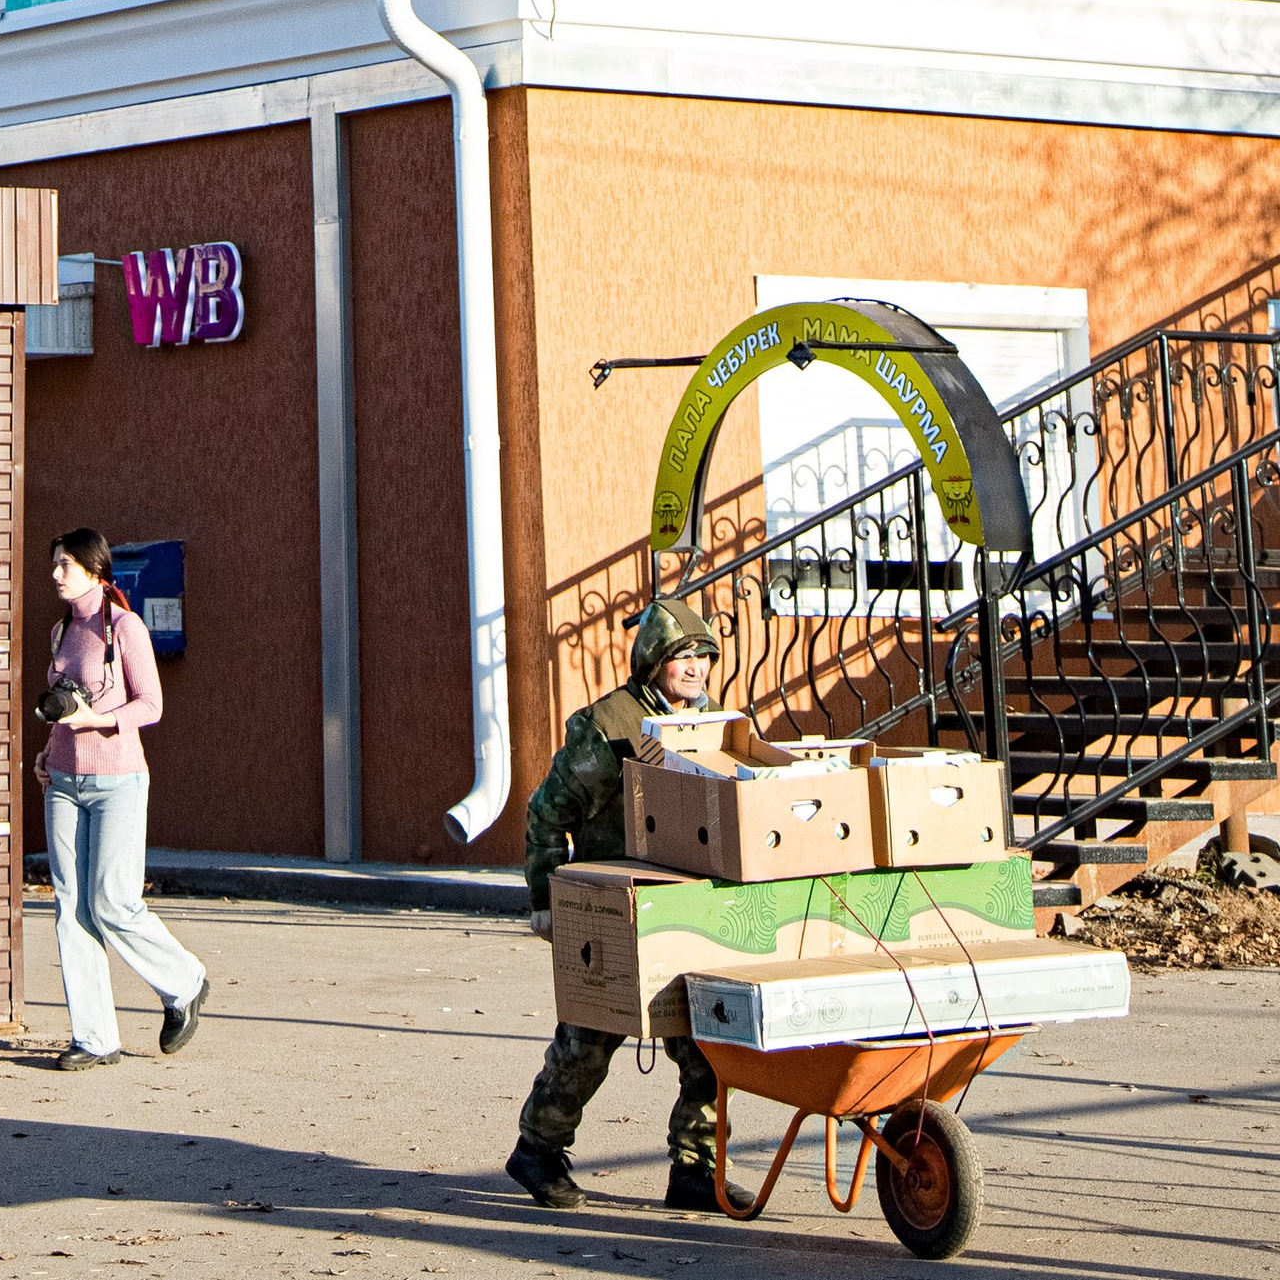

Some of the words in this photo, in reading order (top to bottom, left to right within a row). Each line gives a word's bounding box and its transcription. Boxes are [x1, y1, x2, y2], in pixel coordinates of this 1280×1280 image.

[122, 241, 244, 347] WB
[668, 389, 712, 473] ПАПА
[706, 321, 782, 389] ЧЕБУРЕК
[802, 317, 872, 366] МАМА
[874, 351, 948, 464] ШАУРМА
